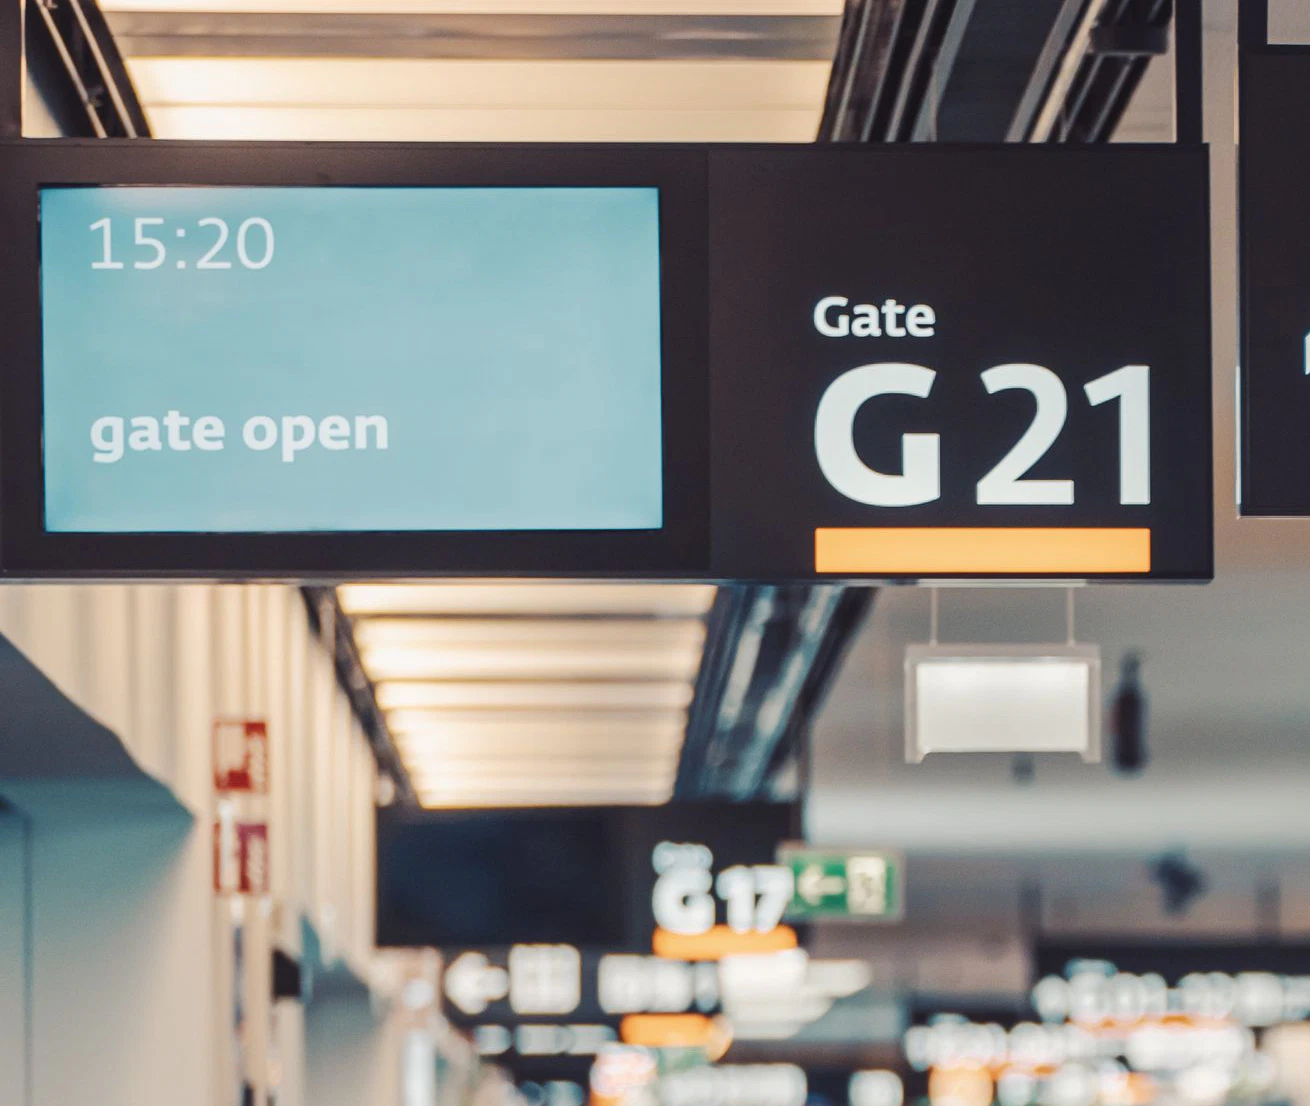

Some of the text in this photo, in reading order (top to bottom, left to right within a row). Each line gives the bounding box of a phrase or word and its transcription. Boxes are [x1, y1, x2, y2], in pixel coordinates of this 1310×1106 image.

[87, 217, 276, 270] 15:20
[813, 296, 936, 338] Gate
[89, 409, 390, 464] gate open
[814, 362, 1151, 508] G 21
[715, 864, 795, 935] 17
